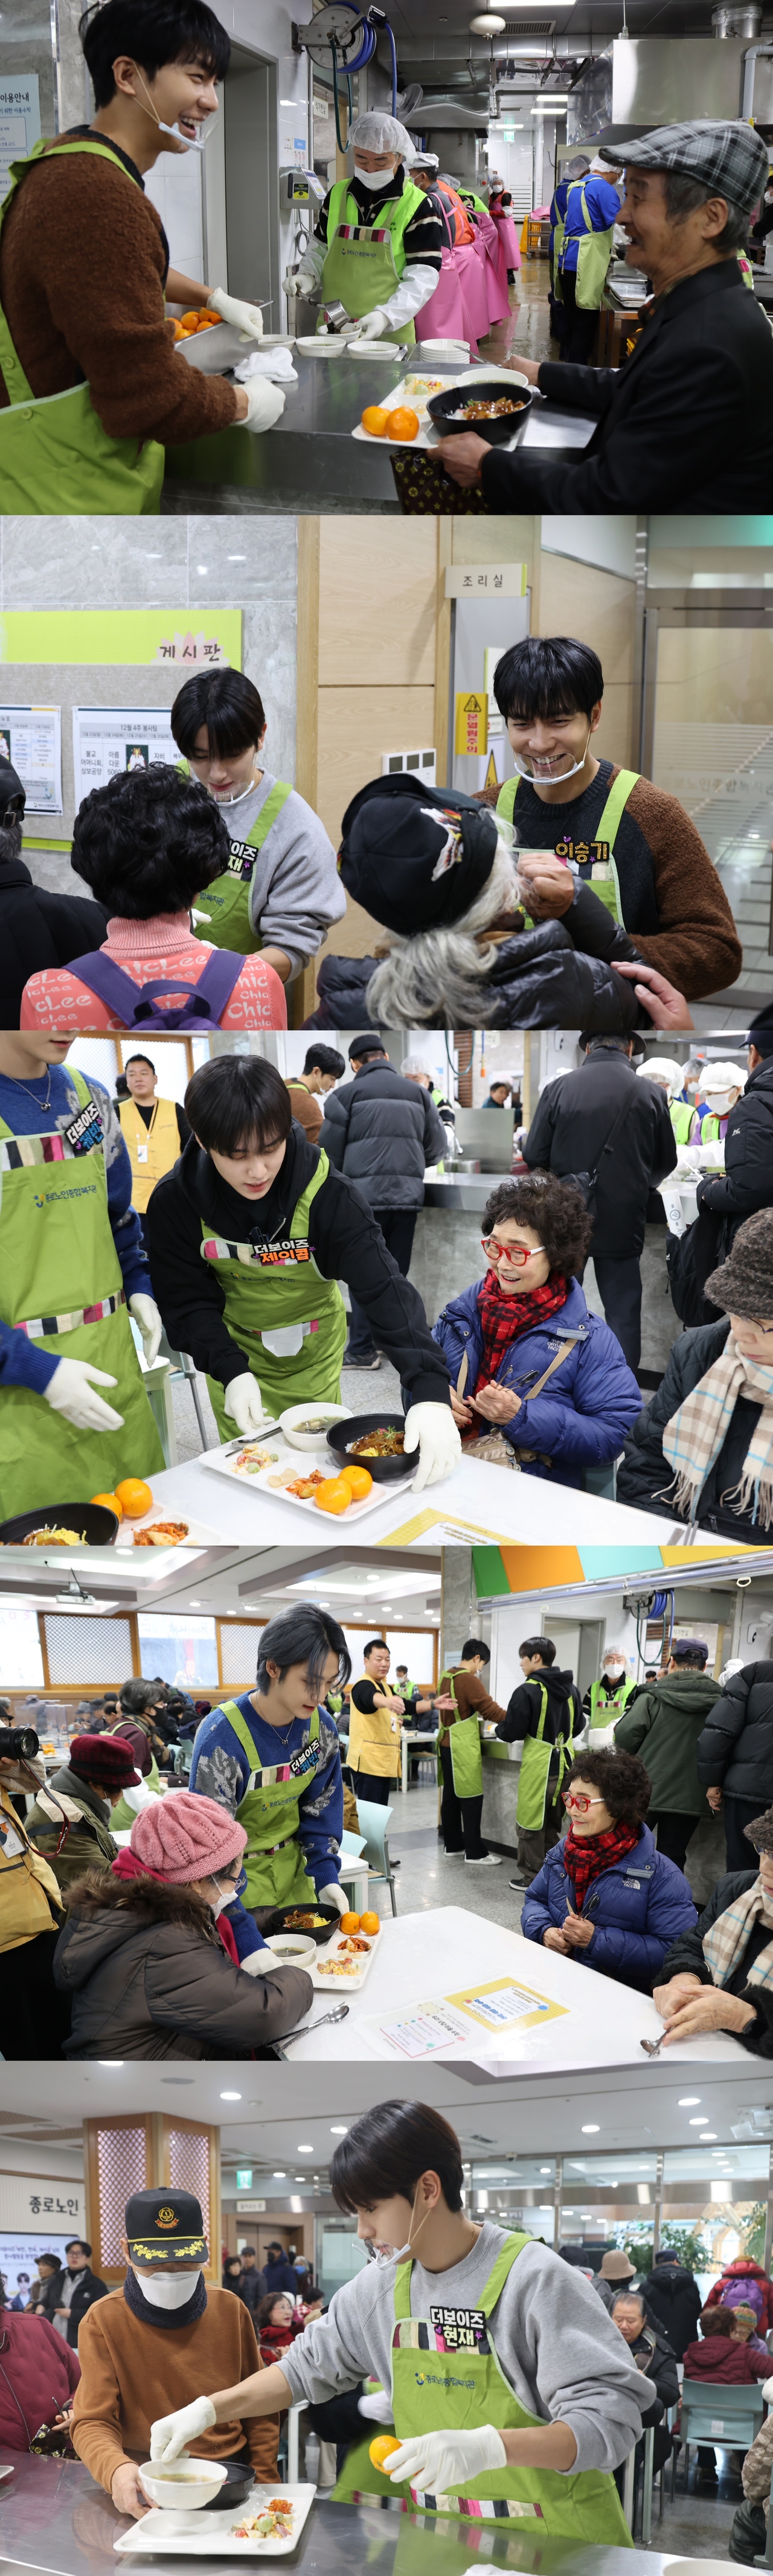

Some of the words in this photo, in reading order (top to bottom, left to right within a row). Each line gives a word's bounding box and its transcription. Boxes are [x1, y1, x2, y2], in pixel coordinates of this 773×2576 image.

[0, 92, 29, 103] 이용안내
[315, 103, 326, 115] 식기반납
[463, 574, 502, 588] 조리실
[159, 643, 220, 662] 게시판
[230, 841, 257, 861] 이즈
[556, 842, 608, 863] 이승기
[228, 855, 243, 872] 재
[66, 1103, 99, 1145] 더보이즈
[79, 1121, 104, 1149] 케빈
[254, 1239, 309, 1254] 더보이즈
[260, 1248, 309, 1263] 제이콥
[291, 1739, 320, 1772] 더보이즈
[300, 1752, 319, 1772] 케빈
[29, 2196, 79, 2216] 종로노인
[431, 2308, 484, 2329] 더보이즈
[443, 2325, 475, 2347] 현재
